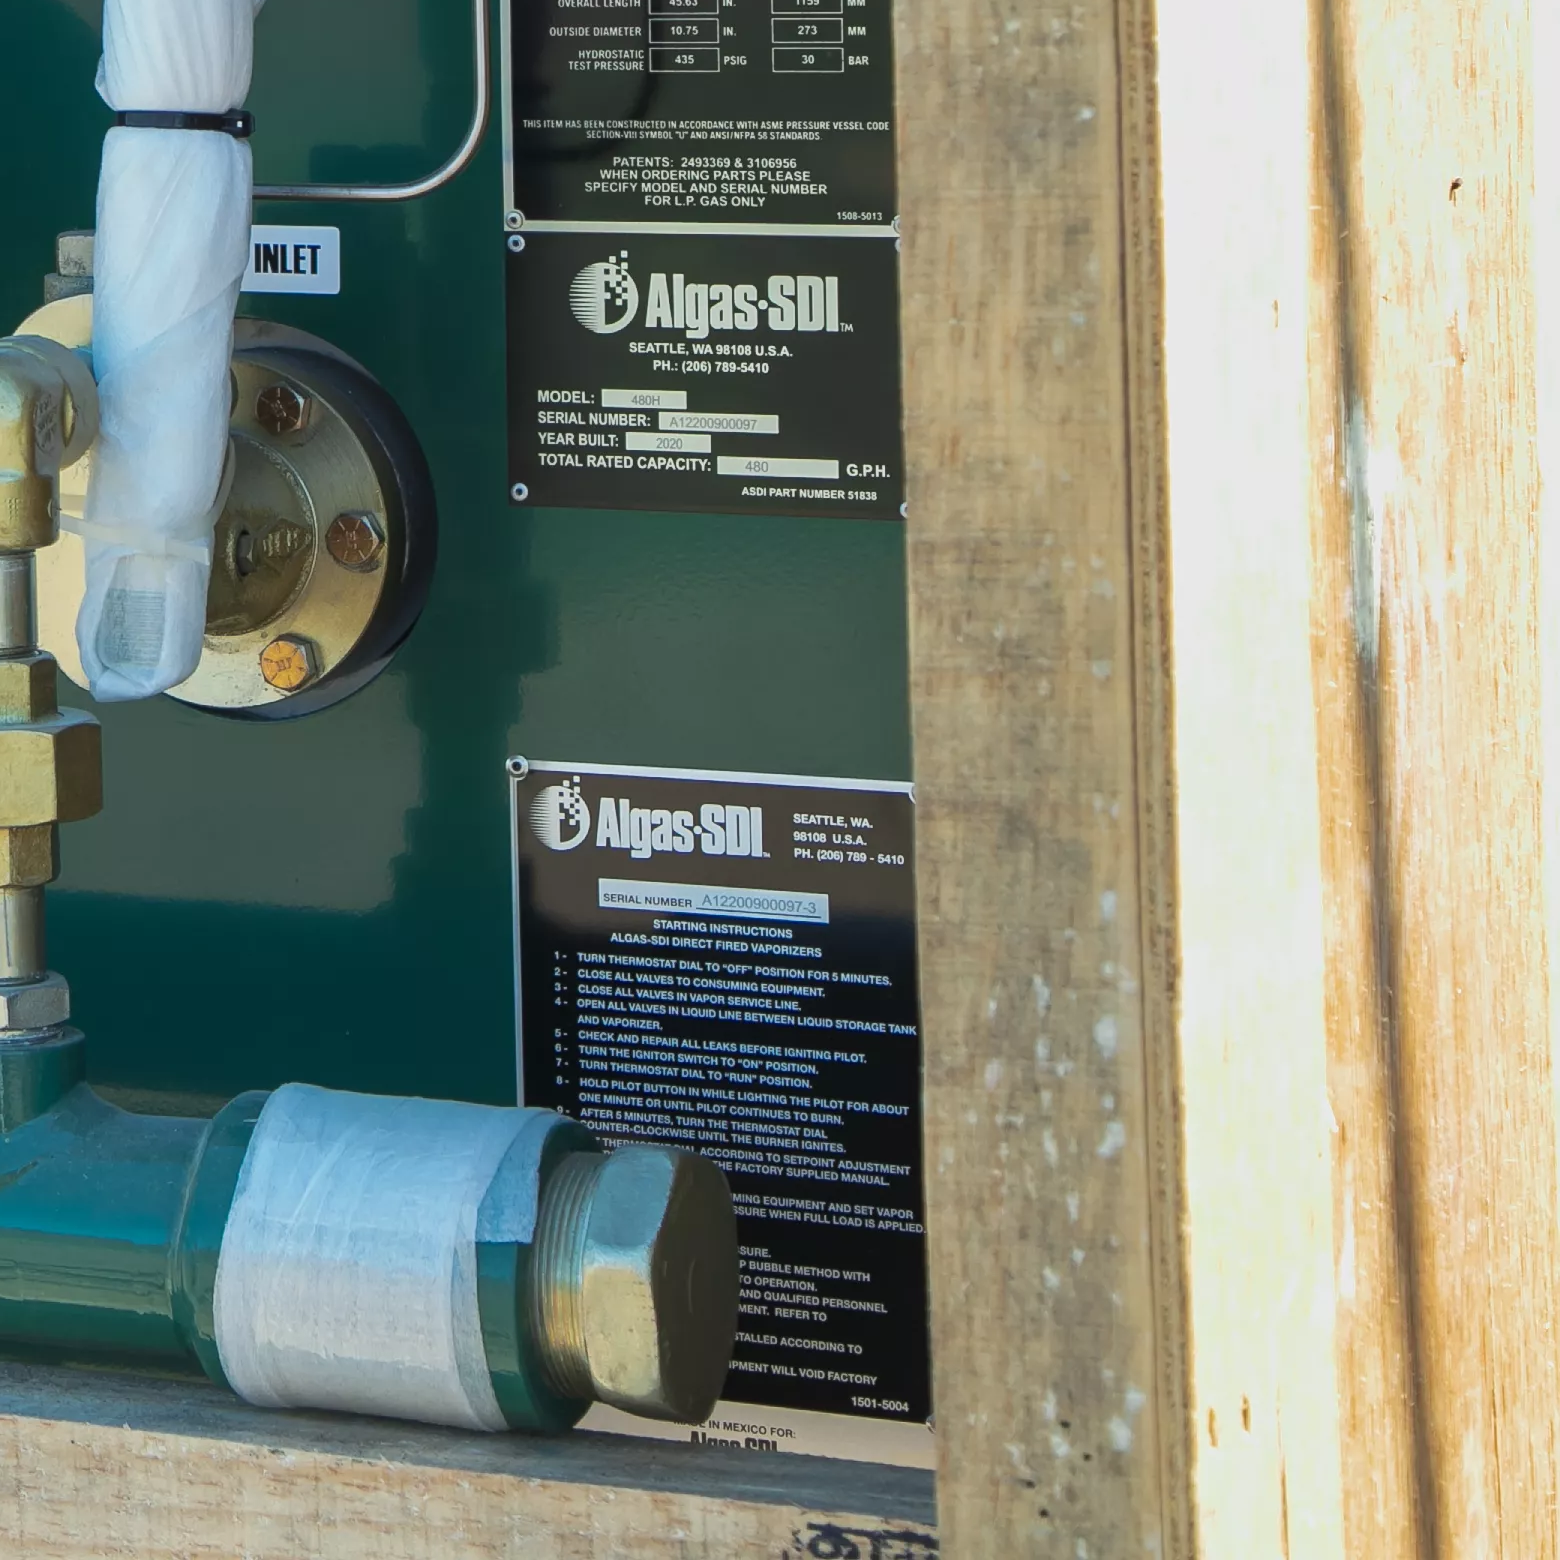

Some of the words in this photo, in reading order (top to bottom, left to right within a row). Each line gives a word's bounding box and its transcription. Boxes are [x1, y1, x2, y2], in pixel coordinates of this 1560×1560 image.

[613, 156, 674, 168] PATENTS:
[681, 157, 730, 168] 2493369
[747, 158, 797, 168] 3106956
[254, 244, 321, 275] INLET
[692, 344, 714, 354] WA
[716, 344, 752, 356] 98108
[755, 345, 793, 357] U.S.A.
[682, 360, 712, 374] (206)
[714, 361, 769, 374] 789-5410
[538, 390, 594, 404] MODEL:
[631, 395, 661, 406] 480H
[538, 411, 586, 425] SERIAL
[589, 412, 651, 426] NUMBER:
[538, 432, 575, 446] YEAR
[578, 433, 618, 447] BUILT:
[656, 438, 683, 449] 2020
[538, 453, 583, 467] TOTAL
[587, 454, 634, 468] RATED
[637, 456, 711, 472] CAPACITY:
[745, 461, 769, 473] 480
[846, 464, 890, 478] G.P.H.
[741, 486, 766, 496] ASDI
[769, 488, 797, 498] PART
[799, 488, 845, 500] NUMBER
[848, 490, 877, 501] 51838
[793, 831, 827, 843] 98108
[832, 834, 867, 846] U.S.A.
[794, 848, 814, 858] PH.
[817, 849, 844, 863] (206)
[846, 851, 867, 862] 789
[878, 854, 904, 865] 5410
[603, 893, 641, 905] SERIAL
[644, 896, 693, 908] NUMBER
[653, 919, 707, 932] STARTING
[710, 923, 793, 938] INSTRUCTIONS
[610, 932, 670, 946] ALGAS-SDI
[672, 937, 713, 949] DIRECT
[716, 940, 749, 952] FIRED
[750, 943, 822, 958] VAPORIZERS
[577, 952, 606, 964] TURN
[608, 954, 677, 968] THERMOSTAT
[679, 960, 703, 971] DIAL
[705, 962, 720, 972] TO
[755, 966, 805, 979] POSITION
[807, 970, 830, 980] FOR
[840, 973, 892, 986] MINUTES.
[851, 1396, 909, 1412] 1501-5004
[709, 1420, 720, 1429] IN
[723, 1422, 767, 1435] MEXICO
